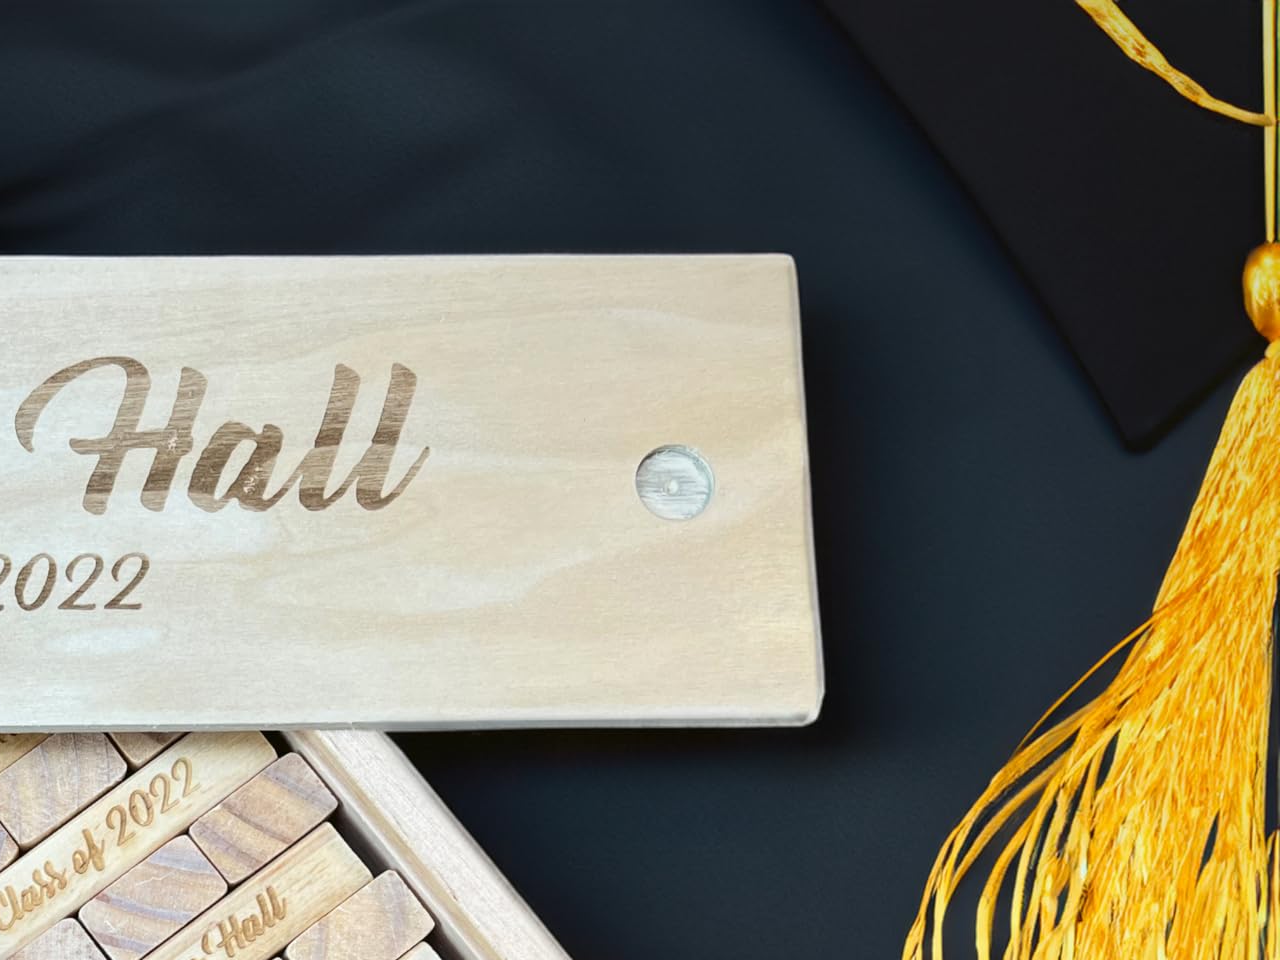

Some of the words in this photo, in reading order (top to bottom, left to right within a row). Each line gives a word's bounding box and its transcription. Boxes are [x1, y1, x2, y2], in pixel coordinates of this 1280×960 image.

[14, 355, 429, 513] Hall
[71, 828, 106, 875] of
[104, 756, 202, 848] 2022
[201, 885, 287, 957] Hall
